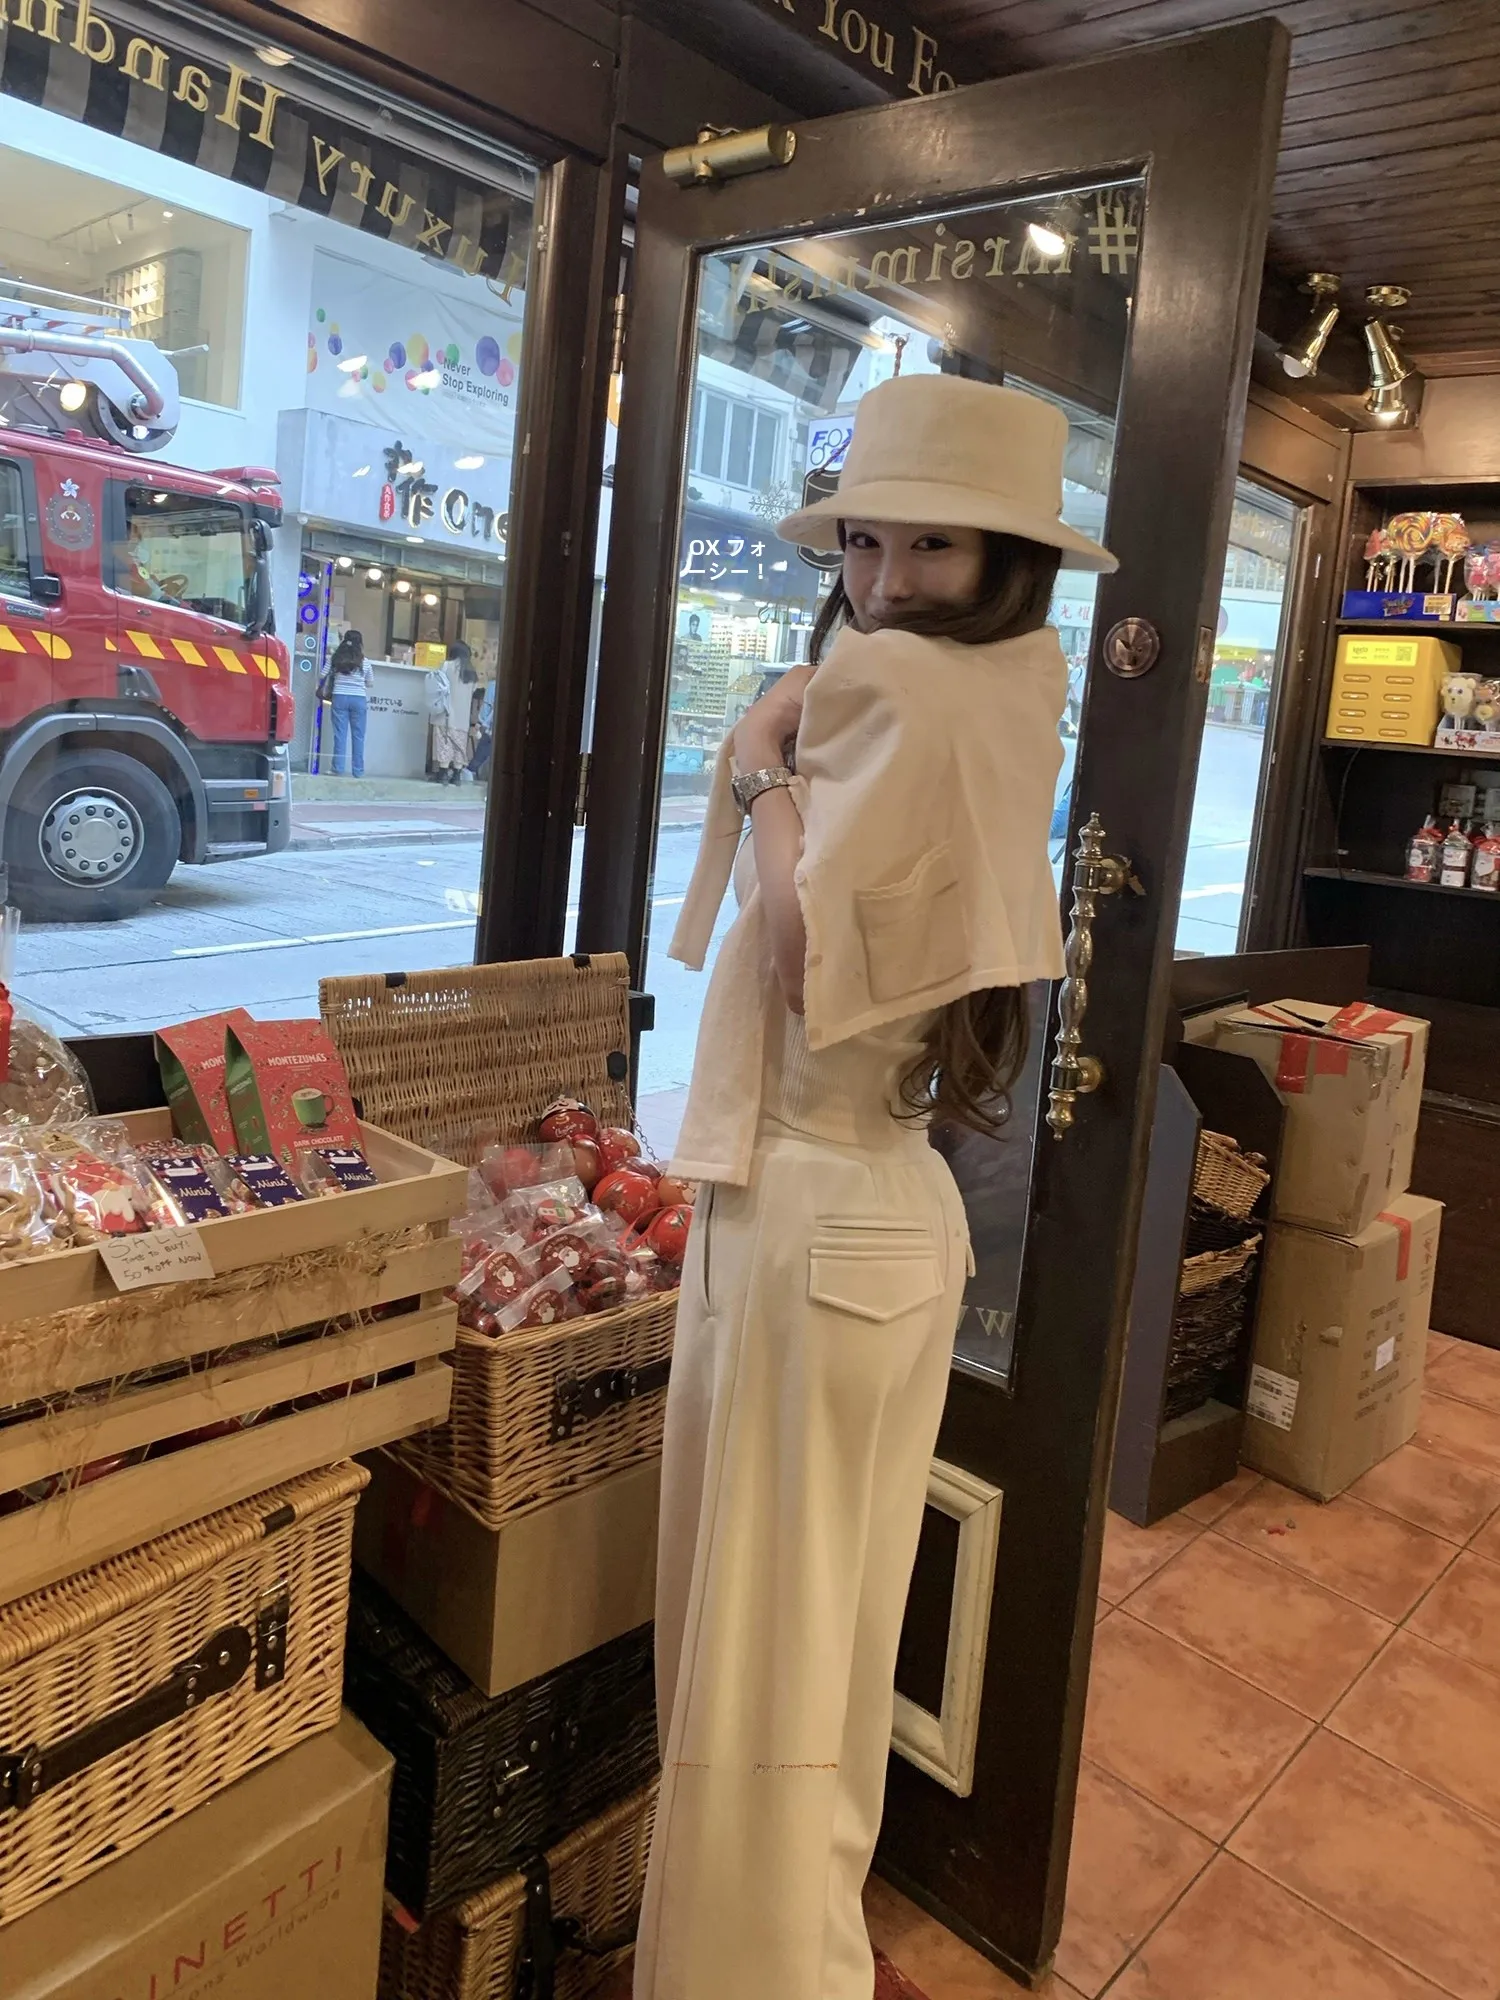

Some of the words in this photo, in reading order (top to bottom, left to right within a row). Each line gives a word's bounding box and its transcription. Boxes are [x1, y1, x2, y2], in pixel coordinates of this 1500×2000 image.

[443, 357, 471, 376] Never
[442, 373, 464, 392] Stop
[466, 381, 509, 407] Exploring
[293, 1139, 310, 1148] DARK
[311, 1134, 345, 1145] CHOCOLATE
[343, 1172, 372, 1182] Minis
[257, 1179, 288, 1190] Minis
[179, 1187, 212, 1198] Minis
[179, 1252, 202, 1264] NOW
[113, 1846, 343, 2000] INETTI
[235, 1888, 341, 1968] Worldwide
